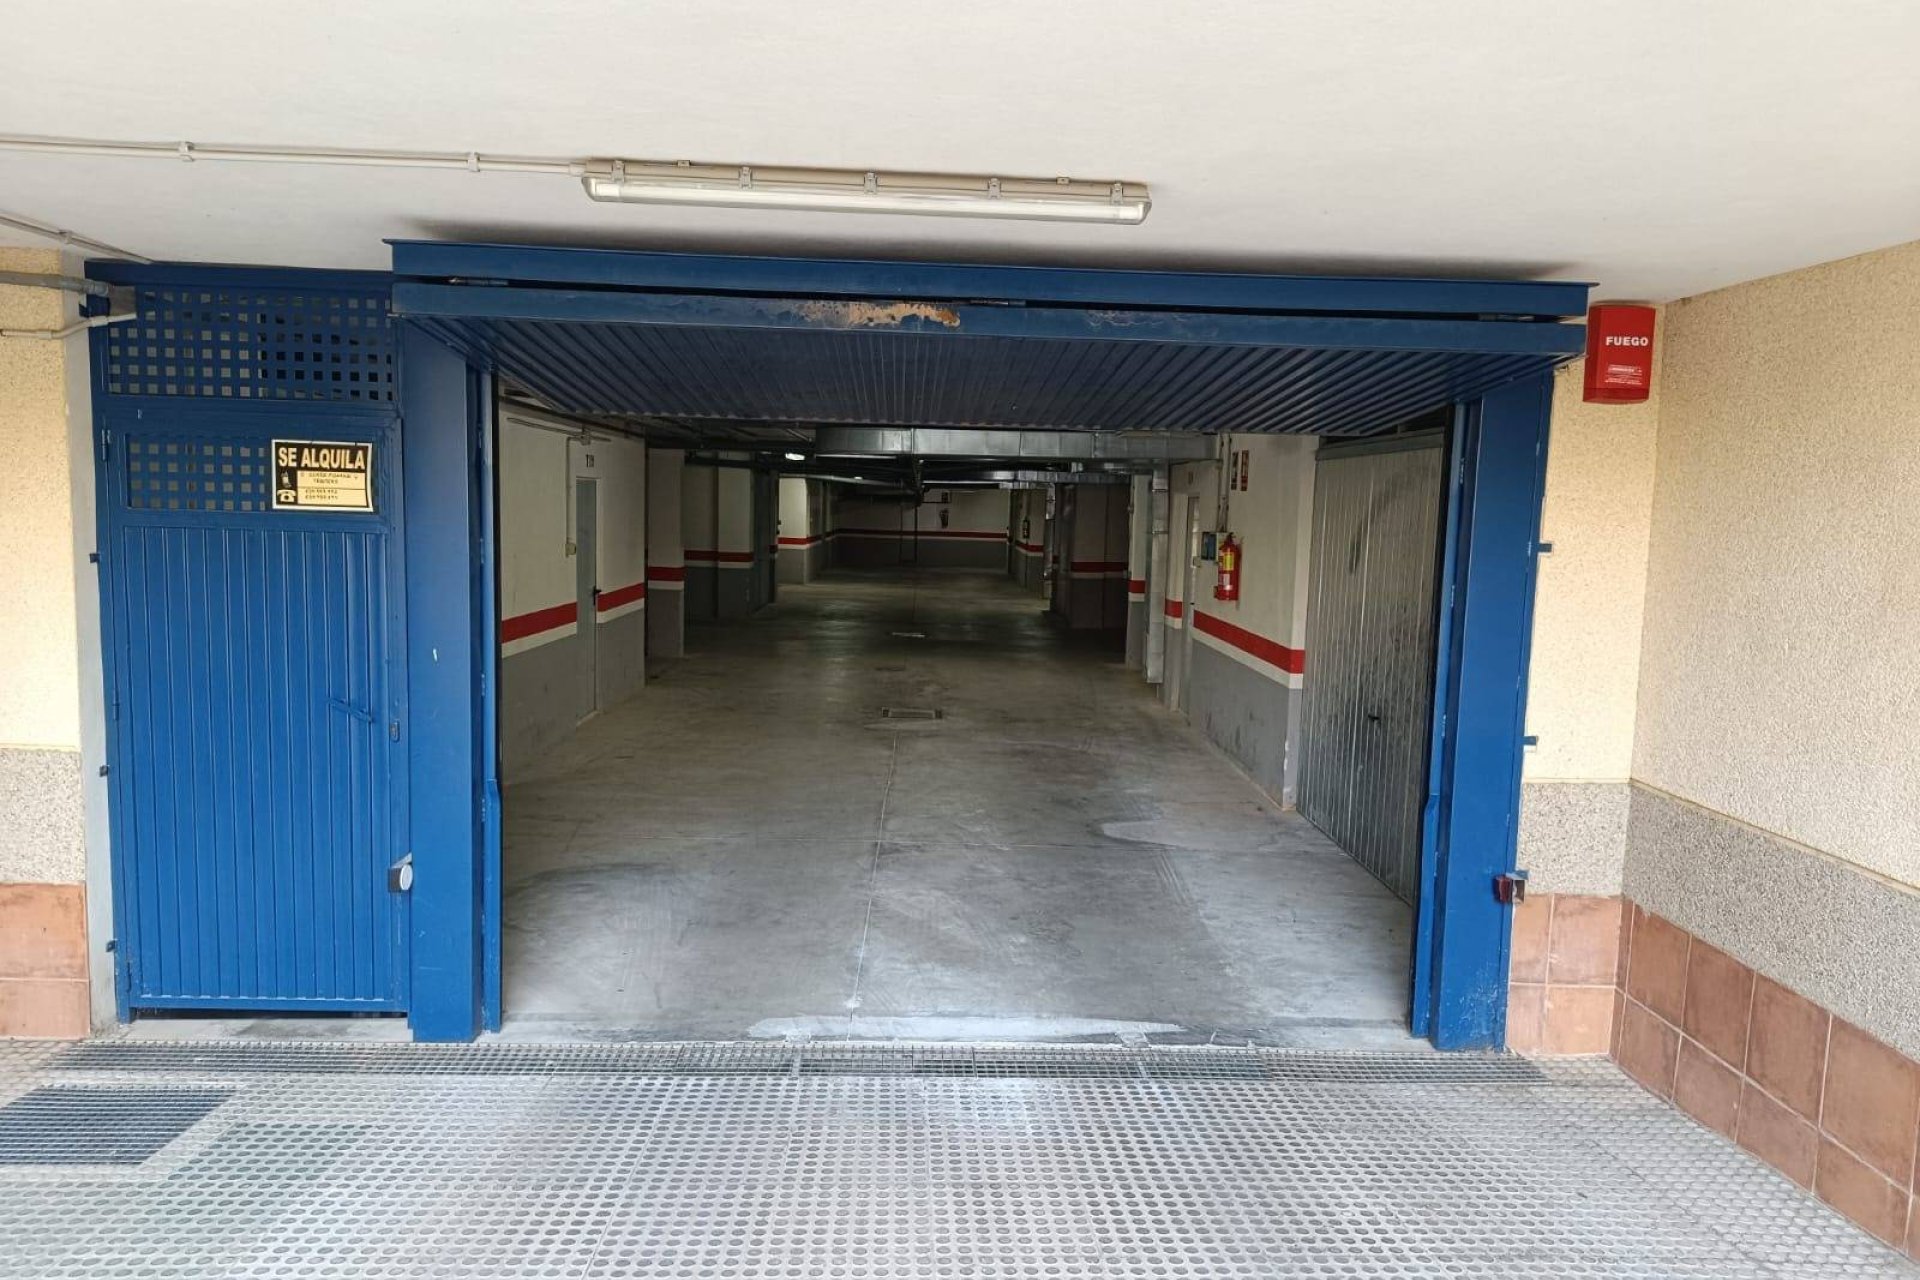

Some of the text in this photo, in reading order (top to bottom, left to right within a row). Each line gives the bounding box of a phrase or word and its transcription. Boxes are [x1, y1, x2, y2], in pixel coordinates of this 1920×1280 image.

[1606, 336, 1648, 347] FUEGO
[278, 447, 365, 470] SE ALQUILA
